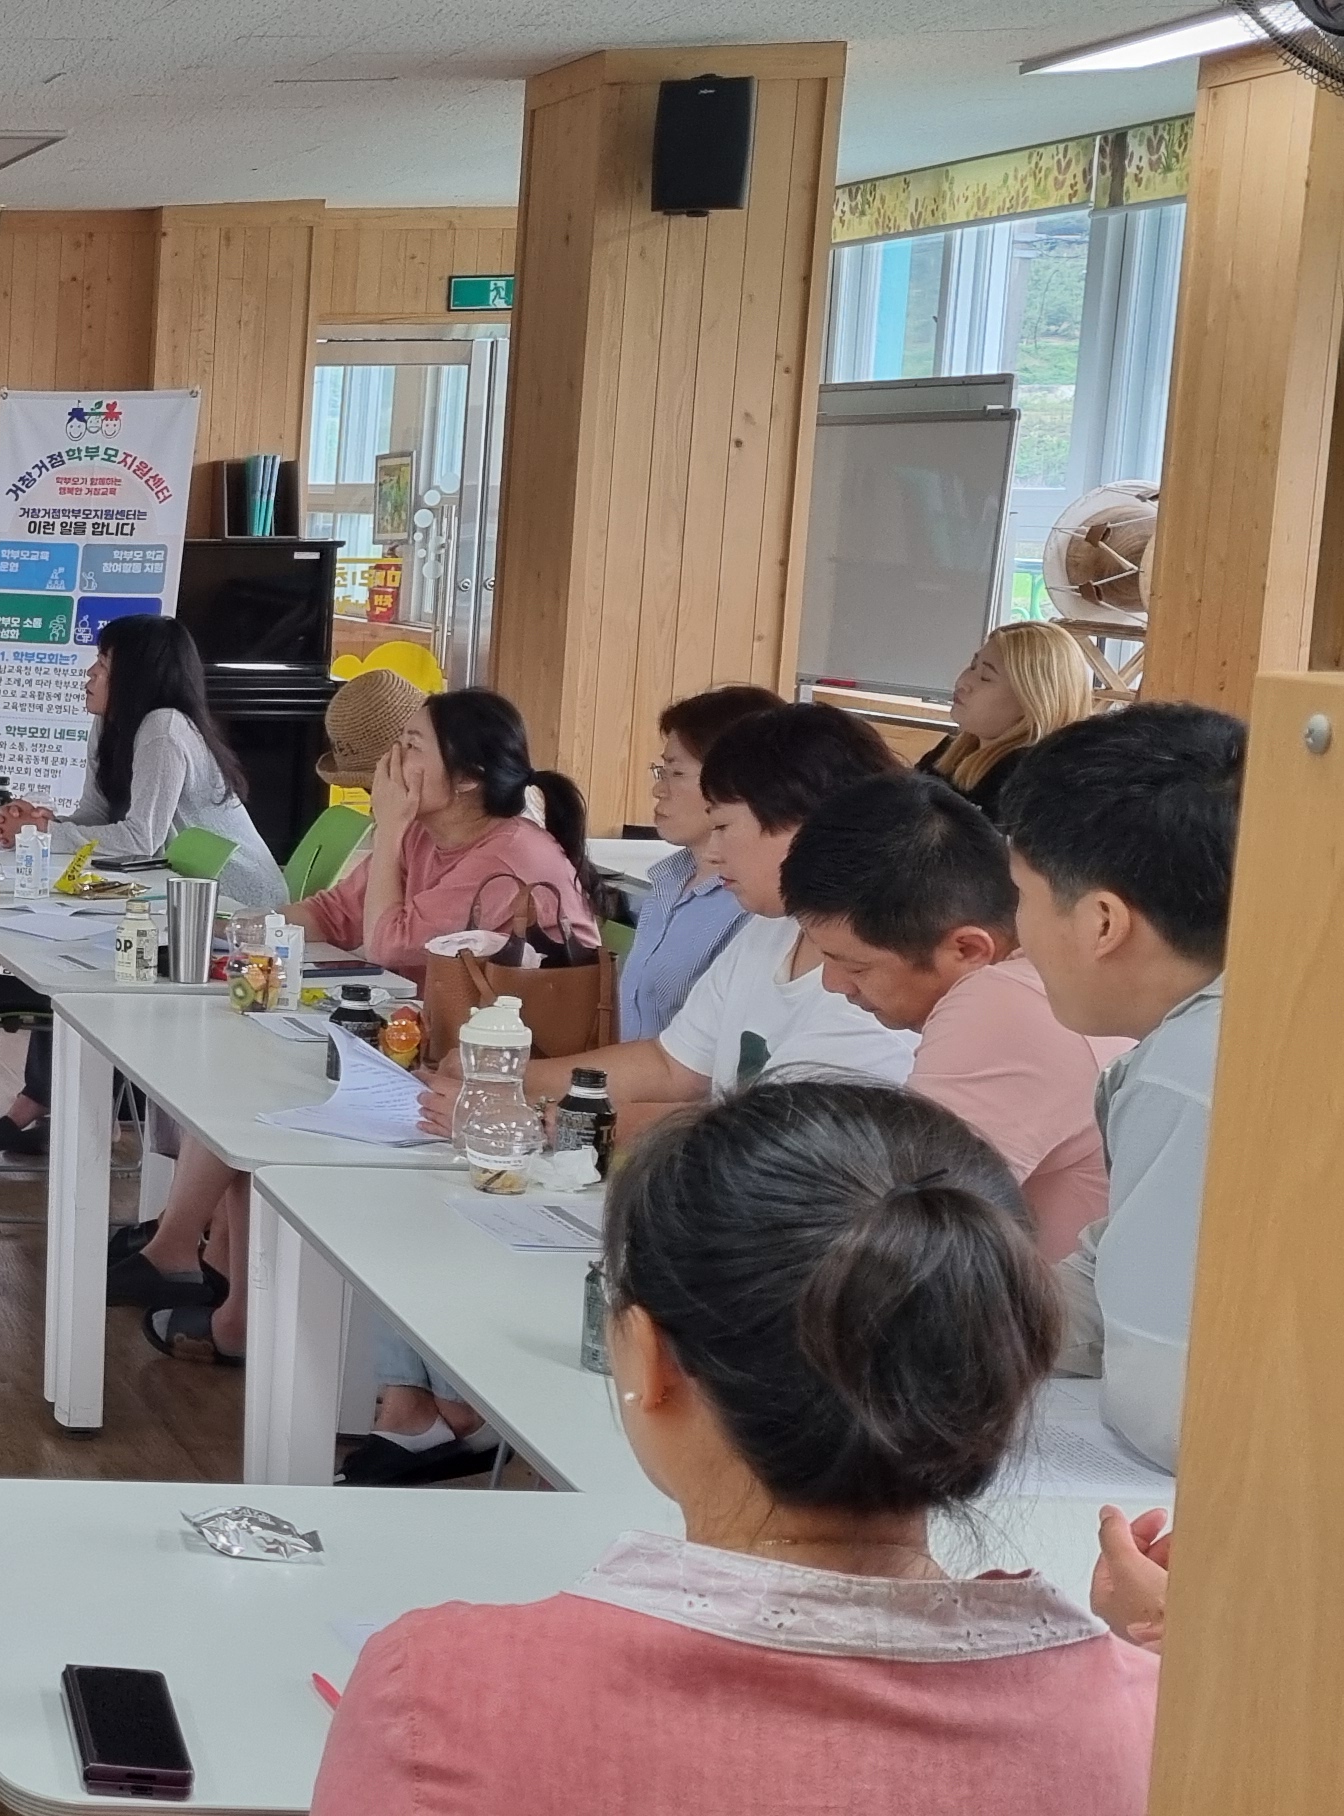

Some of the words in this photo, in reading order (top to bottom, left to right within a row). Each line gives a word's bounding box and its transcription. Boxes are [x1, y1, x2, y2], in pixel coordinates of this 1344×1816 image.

[19, 507, 147, 521] 거창거점학부모지원센터는
[28, 521, 55, 535] 이런
[60, 521, 87, 535] 일을
[92, 521, 135, 536] 합니다
[1, 549, 50, 561] 학부모교육
[113, 550, 143, 561] 학부모
[146, 550, 164, 561] 학교
[13, 651, 77, 665] 학부모회는?
[34, 667, 50, 677] 학교
[35, 679, 52, 689] 따라
[6, 725, 50, 739] 학부모회
